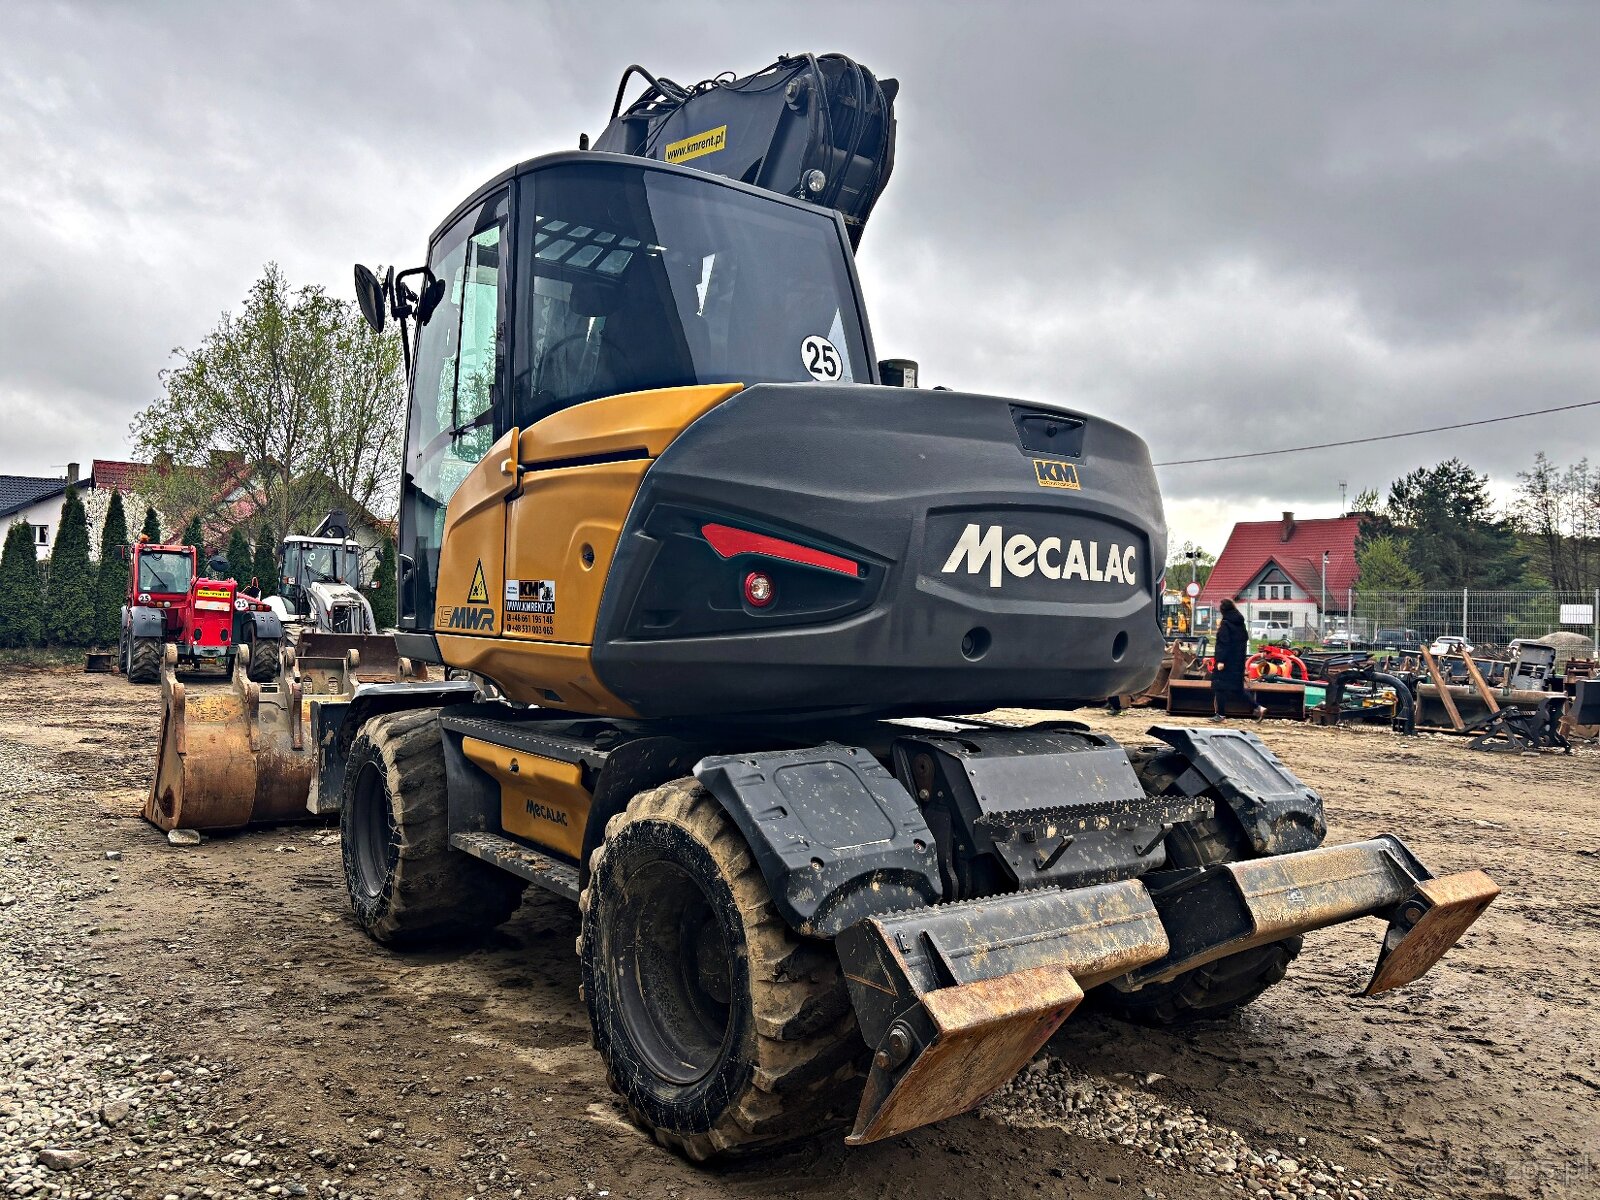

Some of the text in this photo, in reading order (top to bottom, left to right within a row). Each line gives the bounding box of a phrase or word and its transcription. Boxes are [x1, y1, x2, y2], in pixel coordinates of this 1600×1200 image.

[667, 130, 724, 160] www.kmrent.pl
[806, 340, 837, 377] 25
[1036, 461, 1077, 483] KM
[941, 523, 1136, 588] MeCALAC
[519, 581, 539, 596] KM
[236, 600, 246, 608] 25
[506, 601, 554, 613] WWW.KMRENT.PL
